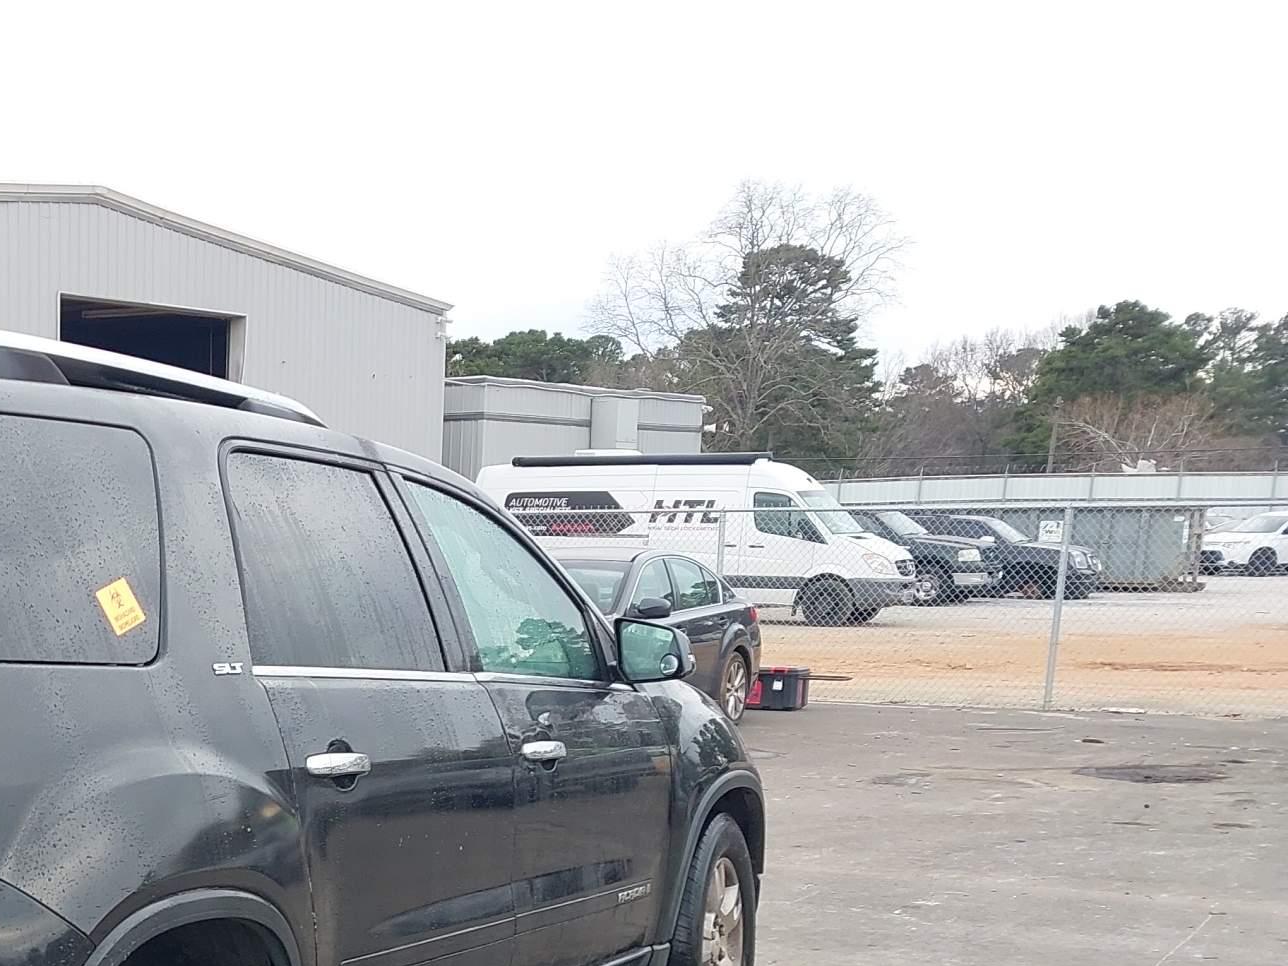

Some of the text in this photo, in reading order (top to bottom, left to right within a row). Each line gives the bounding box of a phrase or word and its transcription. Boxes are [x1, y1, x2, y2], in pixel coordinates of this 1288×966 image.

[509, 497, 569, 507] AUTOMOTIVE
[648, 499, 721, 523] HTL
[212, 662, 244, 675] SLT
